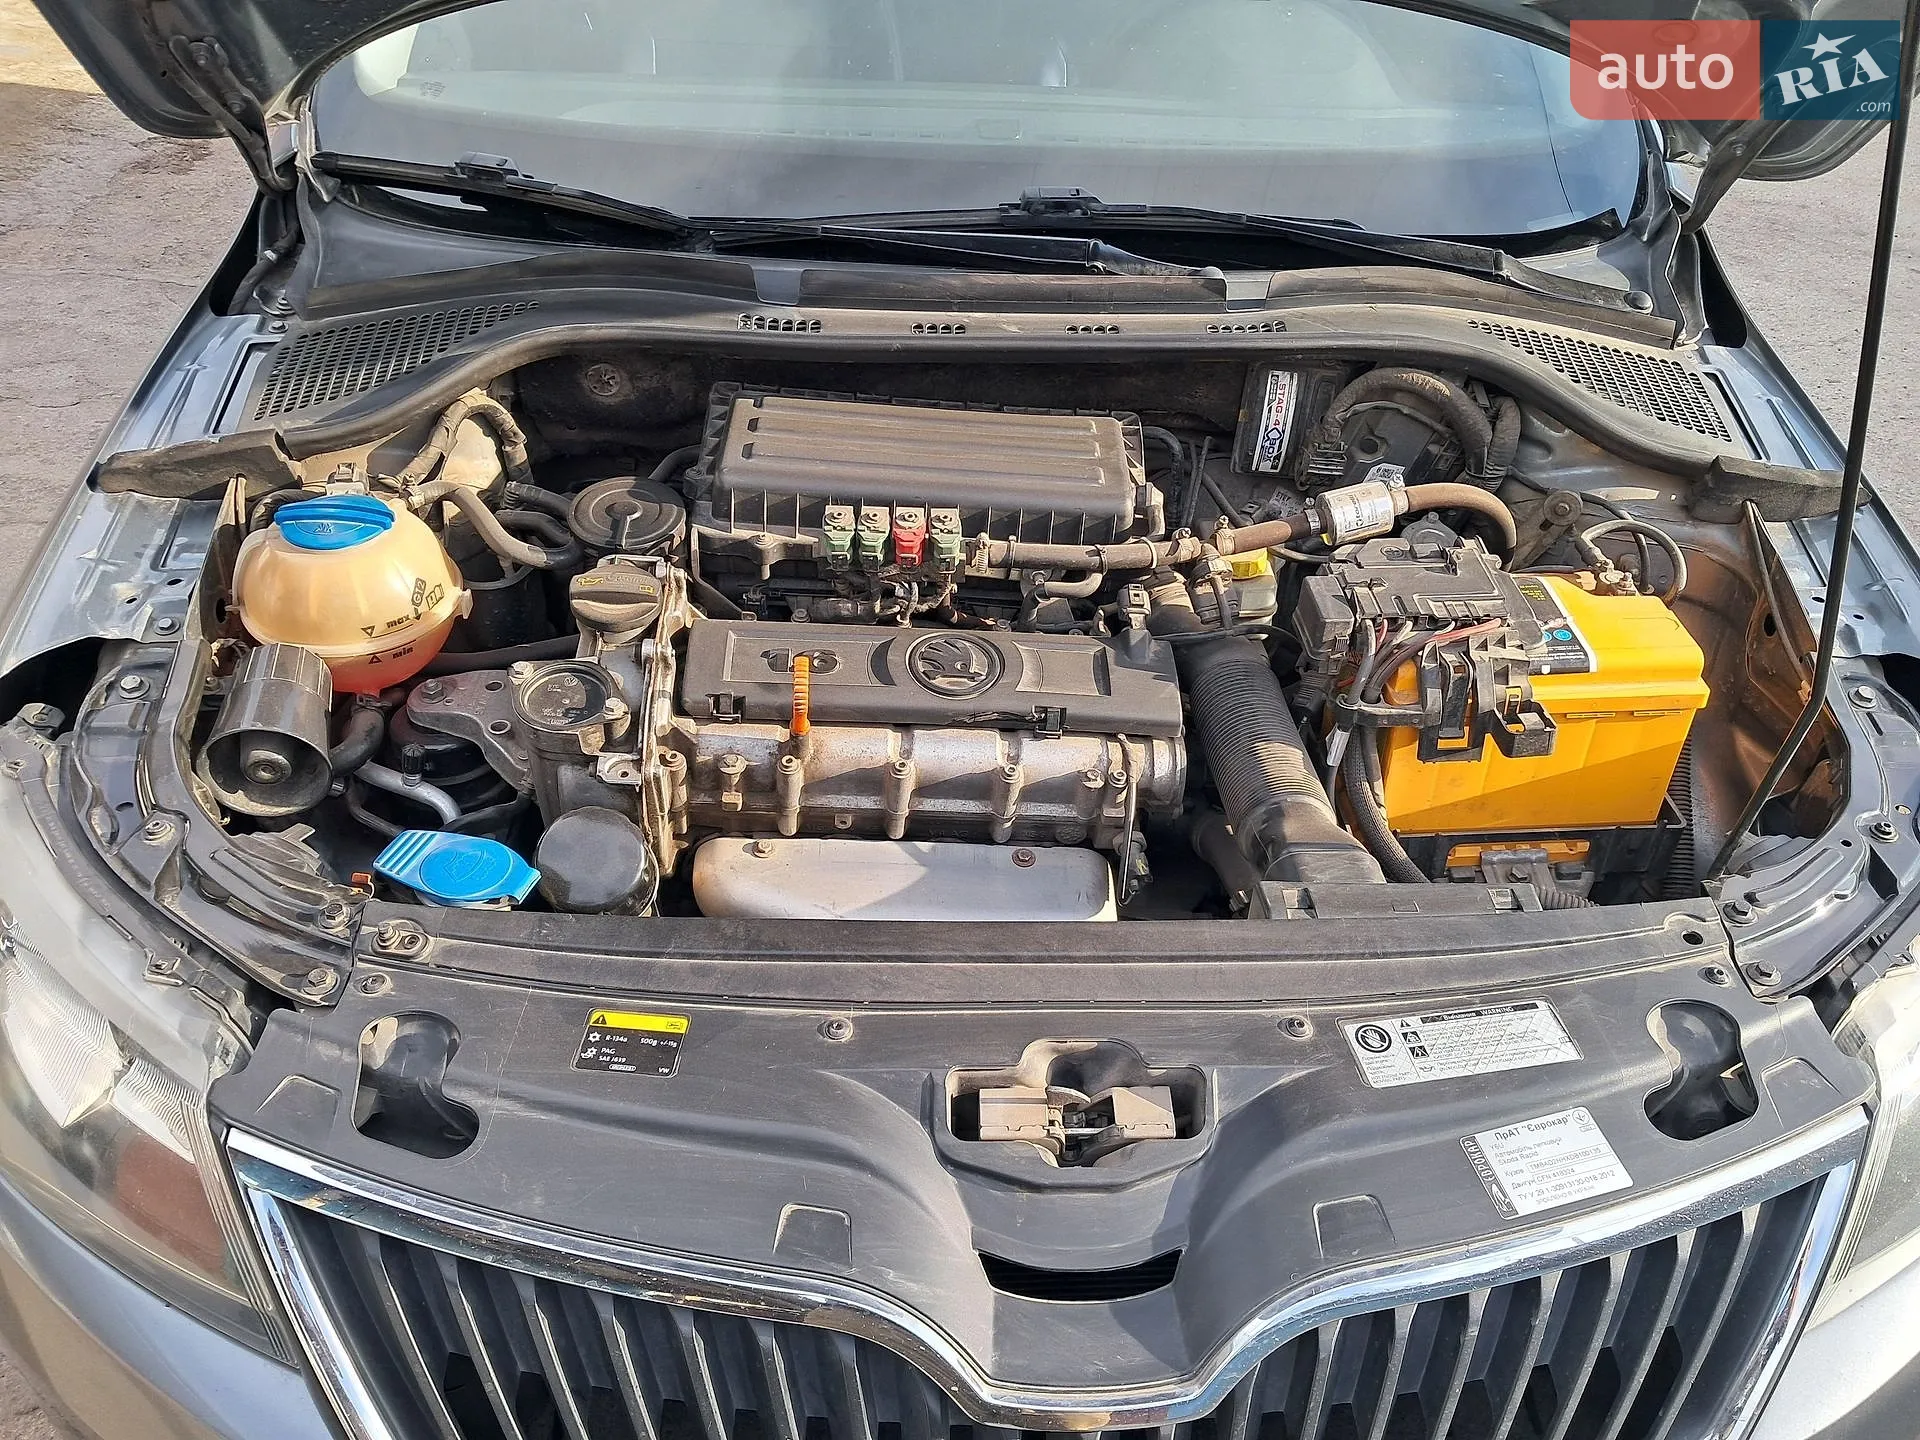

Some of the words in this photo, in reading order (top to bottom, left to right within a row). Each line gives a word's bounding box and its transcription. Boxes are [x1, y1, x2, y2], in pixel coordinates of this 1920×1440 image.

[1273, 383, 1287, 426] STAG-4
[386, 614, 411, 629] max
[392, 647, 414, 659] min
[1480, 1006, 1514, 1015] WARNING
[605, 1034, 627, 1042] R-134a
[640, 1037, 658, 1047] 500g
[601, 1047, 616, 1055] PAG
[1494, 1128, 1522, 1142] ПрАТ
[1521, 1114, 1572, 1134] "Єврокар"
[1463, 1140, 1495, 1182] ЄВРОКАР
[1520, 1150, 1540, 1163] Rapid
